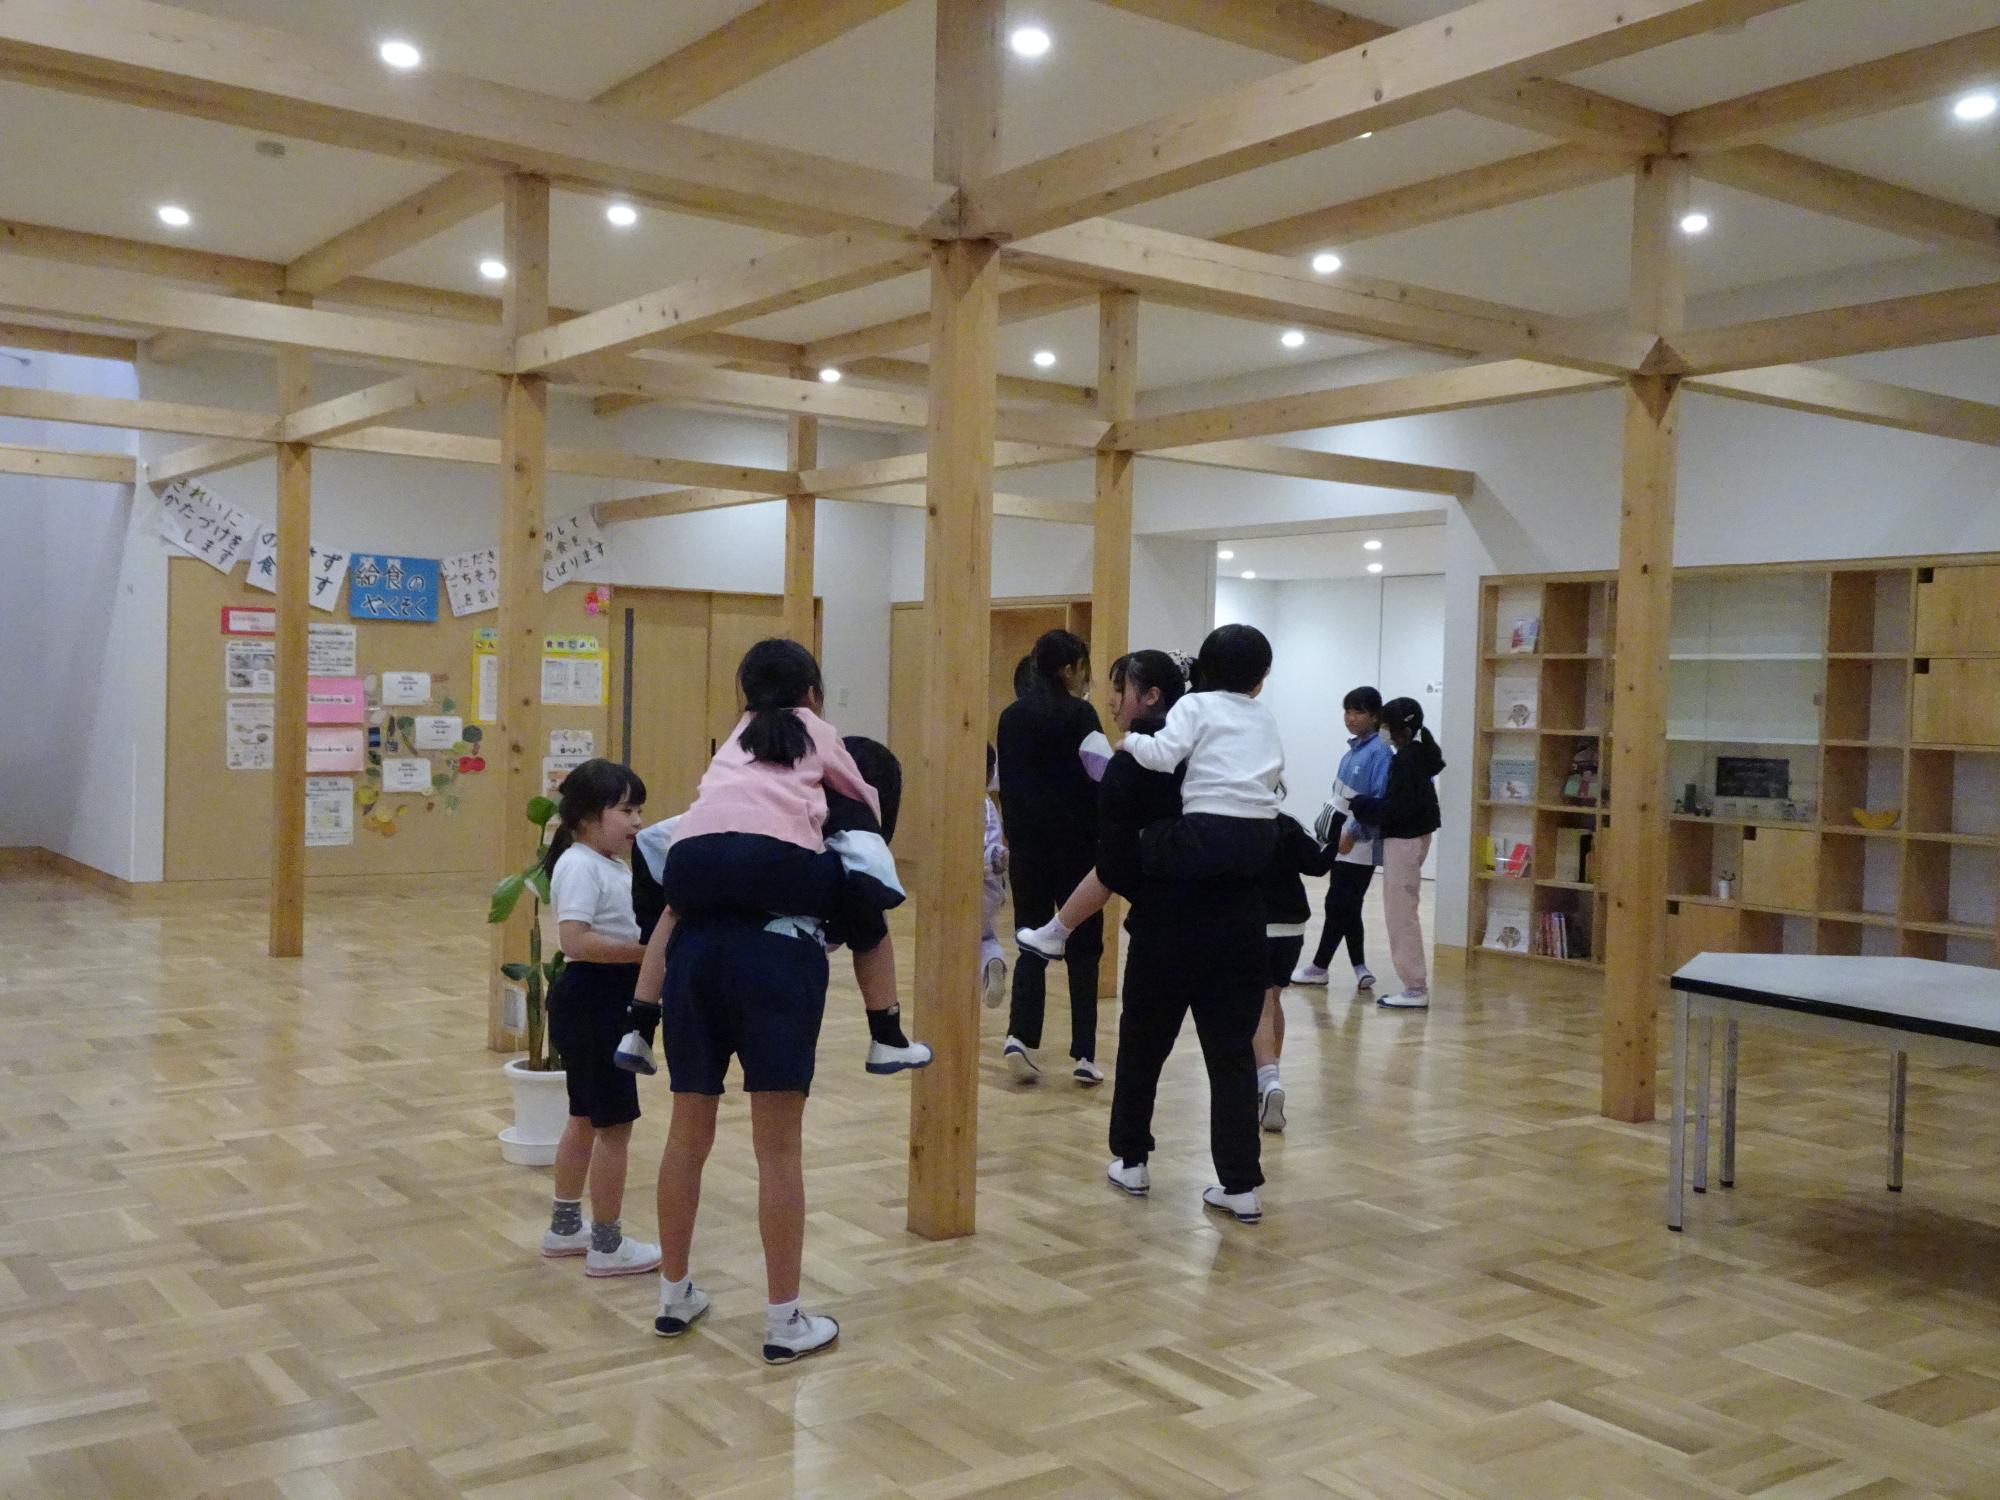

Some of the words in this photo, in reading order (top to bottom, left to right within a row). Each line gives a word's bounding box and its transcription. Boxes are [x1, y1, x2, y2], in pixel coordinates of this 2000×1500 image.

[184, 529, 235, 565] します
[353, 562, 425, 590] 給食の
[361, 593, 427, 617] やくそく
